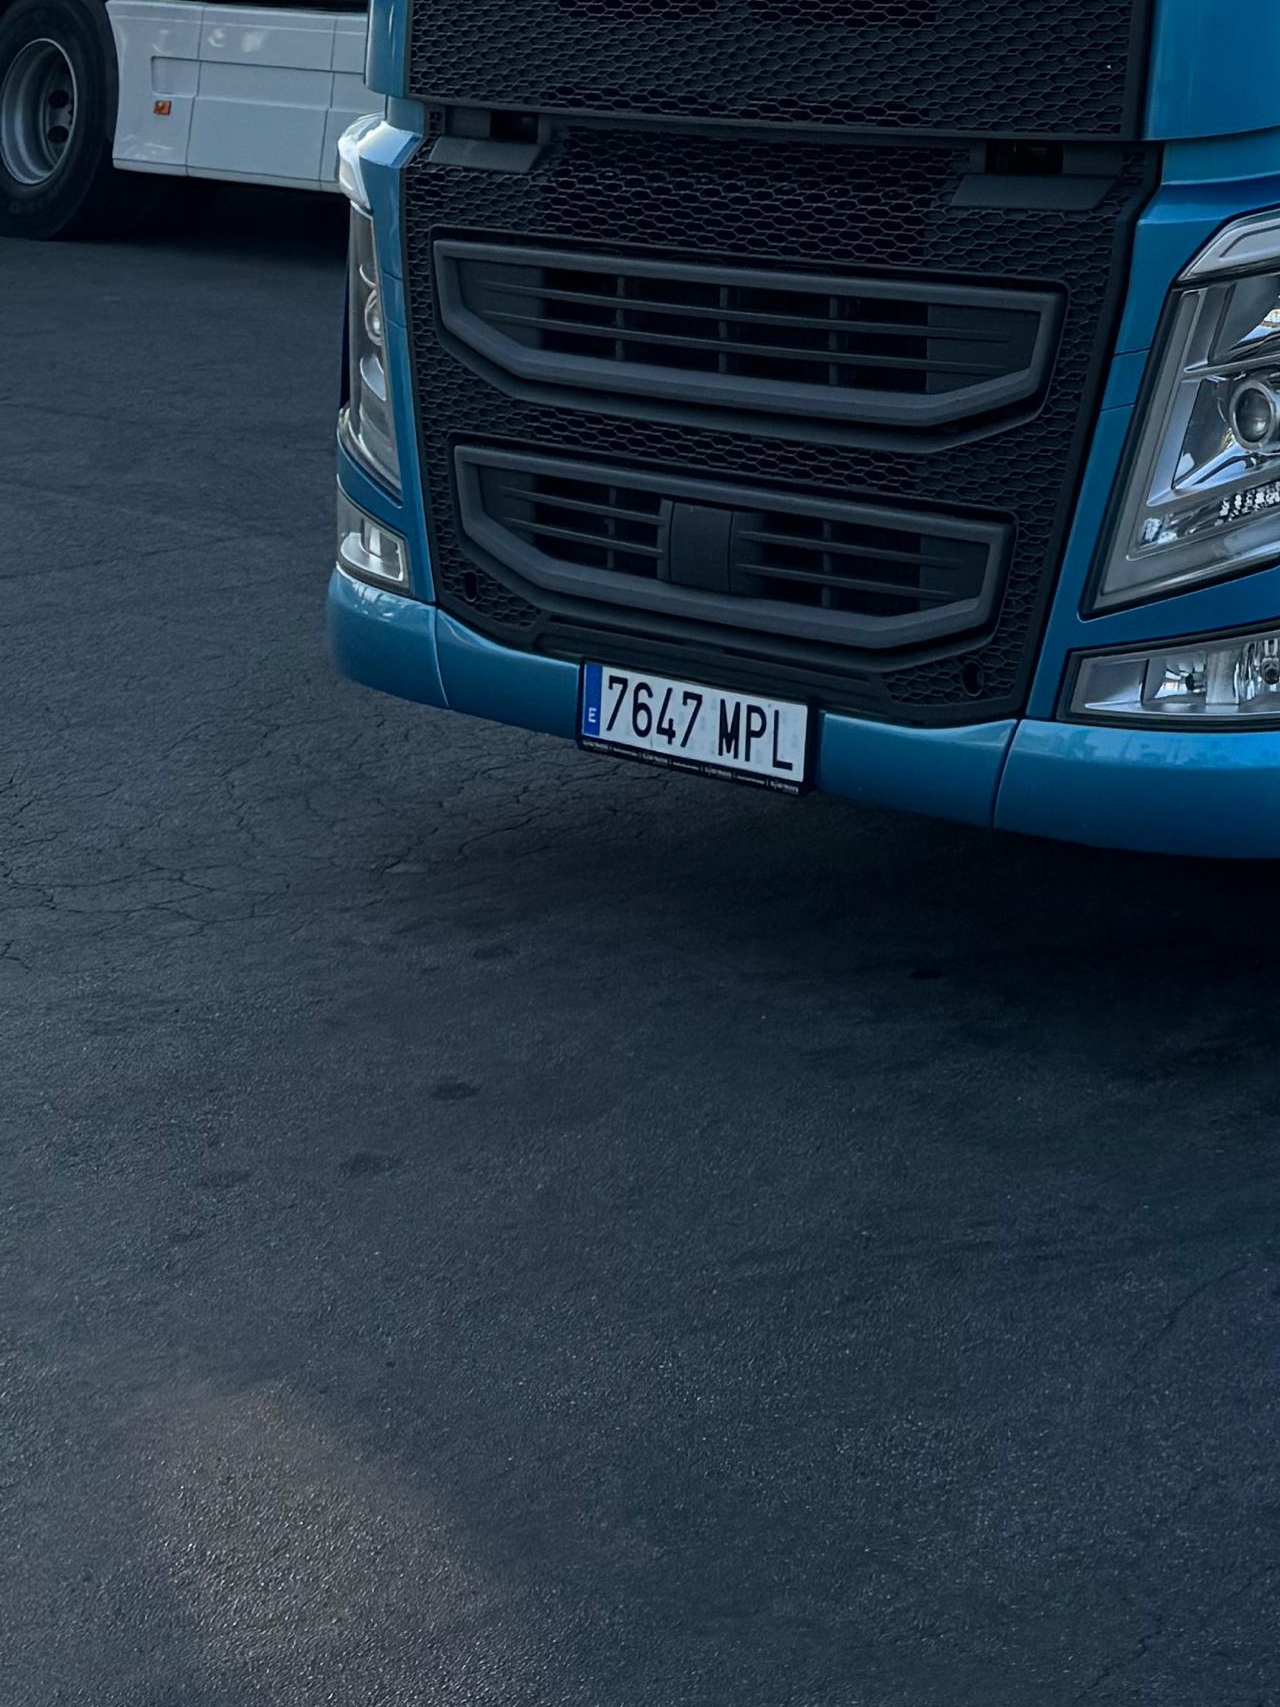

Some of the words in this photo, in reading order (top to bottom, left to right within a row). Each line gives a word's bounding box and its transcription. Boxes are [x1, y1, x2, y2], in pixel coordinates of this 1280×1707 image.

[588, 707, 597, 723] E
[606, 675, 704, 748] 7647
[718, 699, 793, 771] MPL
